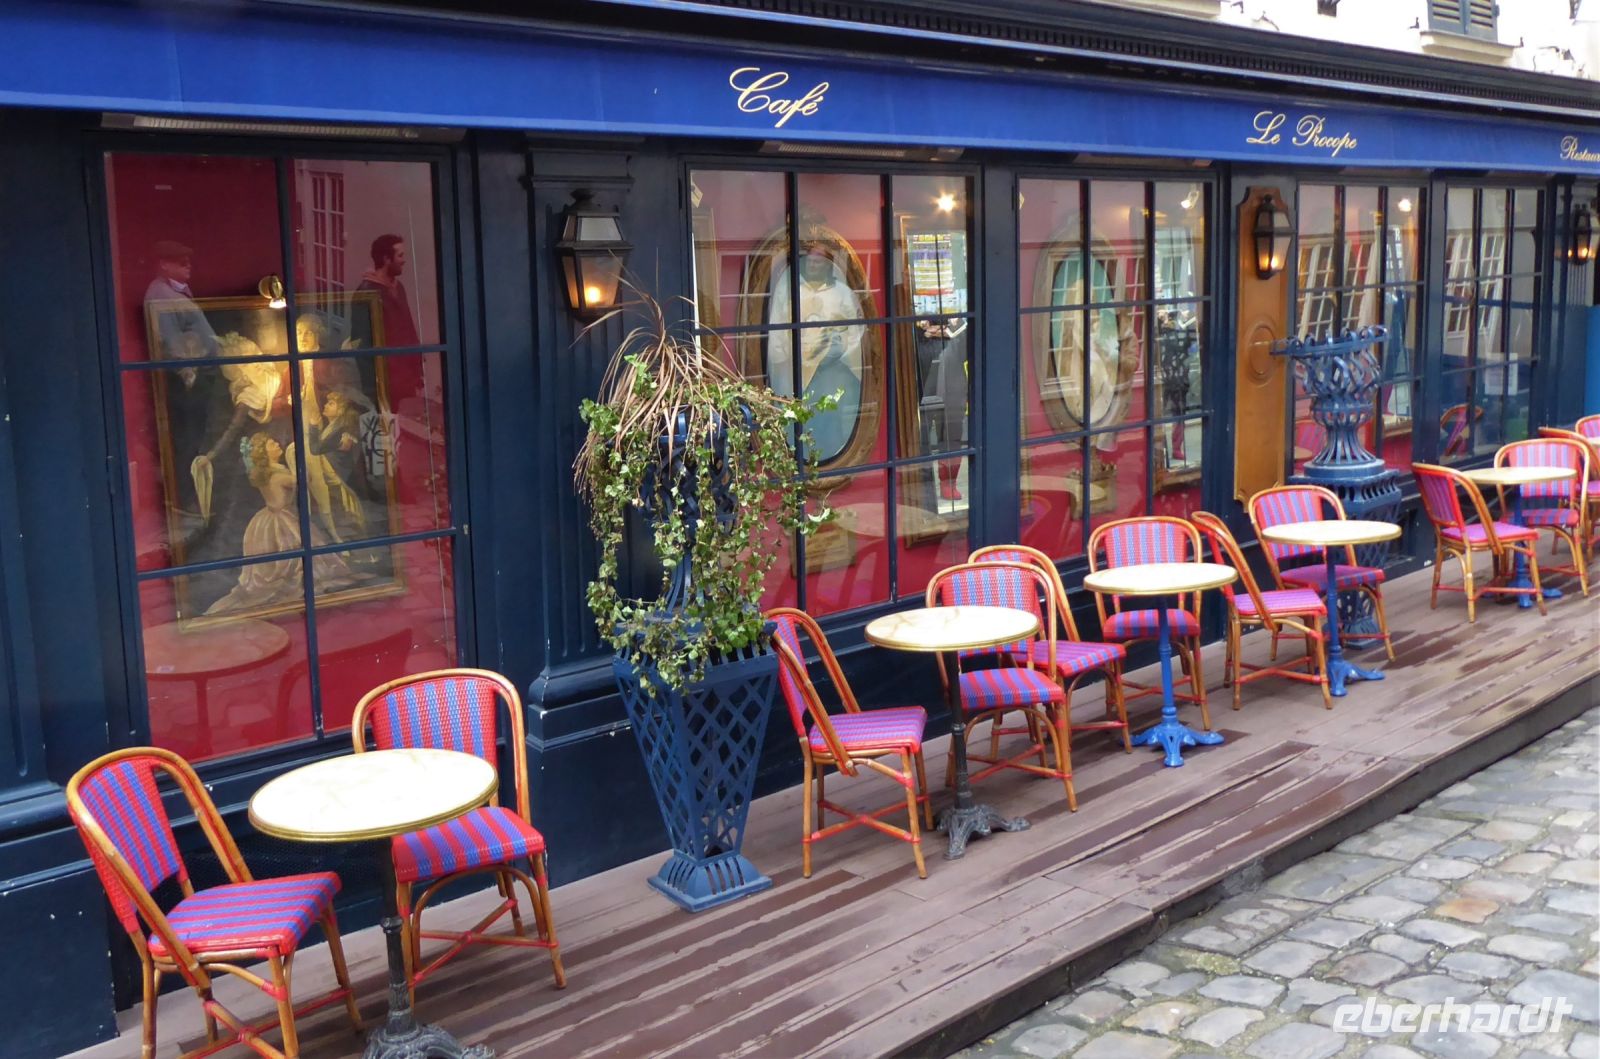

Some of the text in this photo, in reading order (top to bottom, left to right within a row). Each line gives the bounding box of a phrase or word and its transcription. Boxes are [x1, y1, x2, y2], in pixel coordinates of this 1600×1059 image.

[729, 67, 829, 128] Café
[1246, 111, 1358, 157] Le Procope
